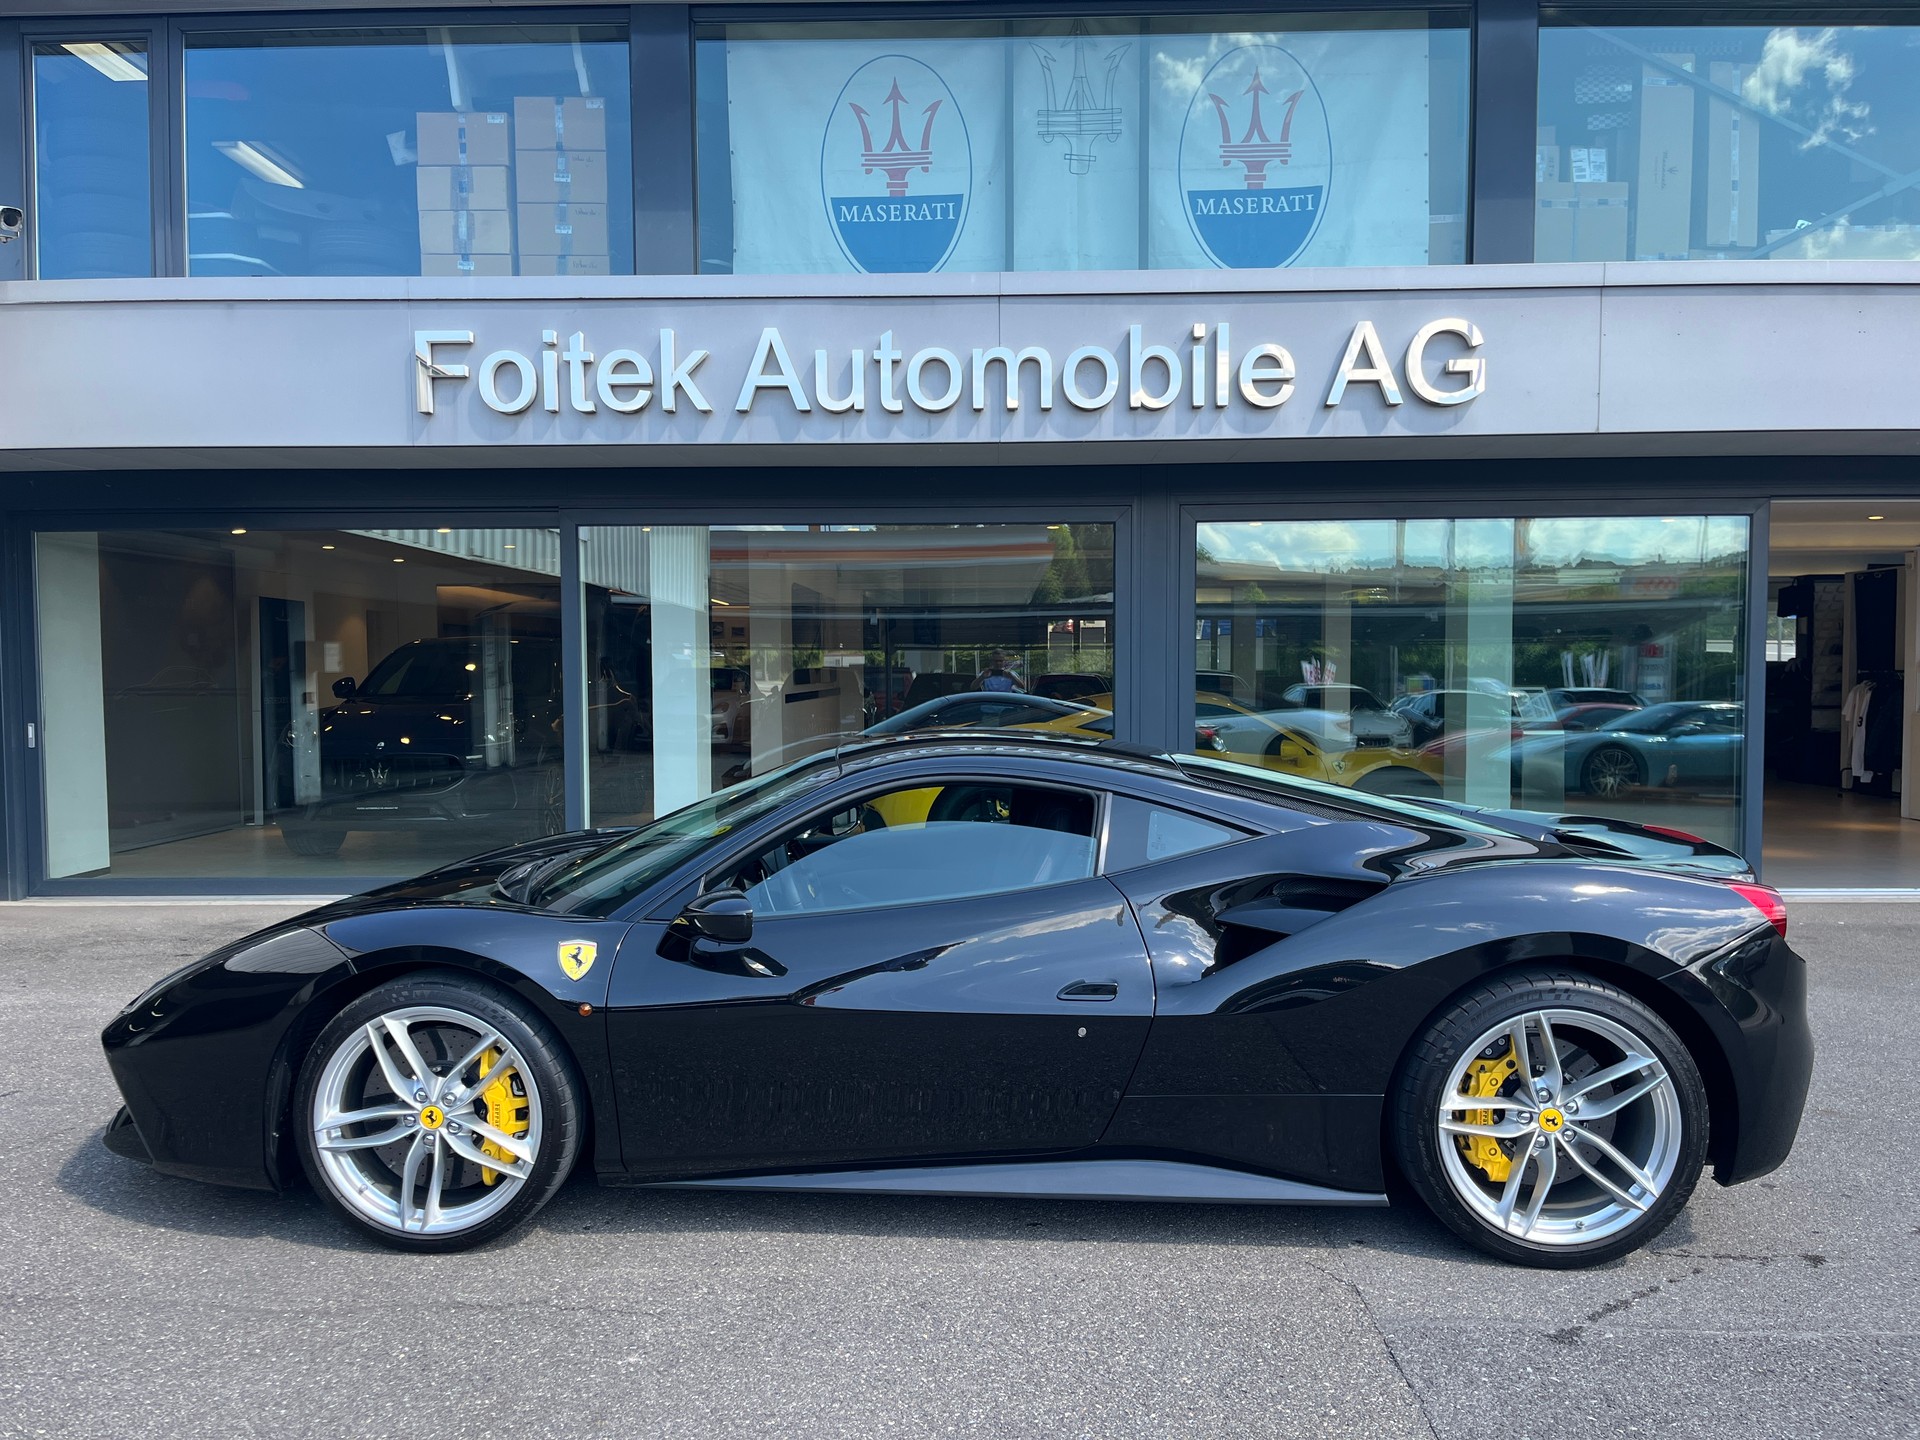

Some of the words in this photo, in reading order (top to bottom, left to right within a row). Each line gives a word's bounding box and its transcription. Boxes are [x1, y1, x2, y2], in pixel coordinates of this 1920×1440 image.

[839, 202, 956, 222] MASERATI
[1195, 193, 1315, 215] MASERATI
[414, 326, 714, 415] Foitek
[735, 322, 1296, 413] Automobile
[1325, 317, 1486, 407] AG
